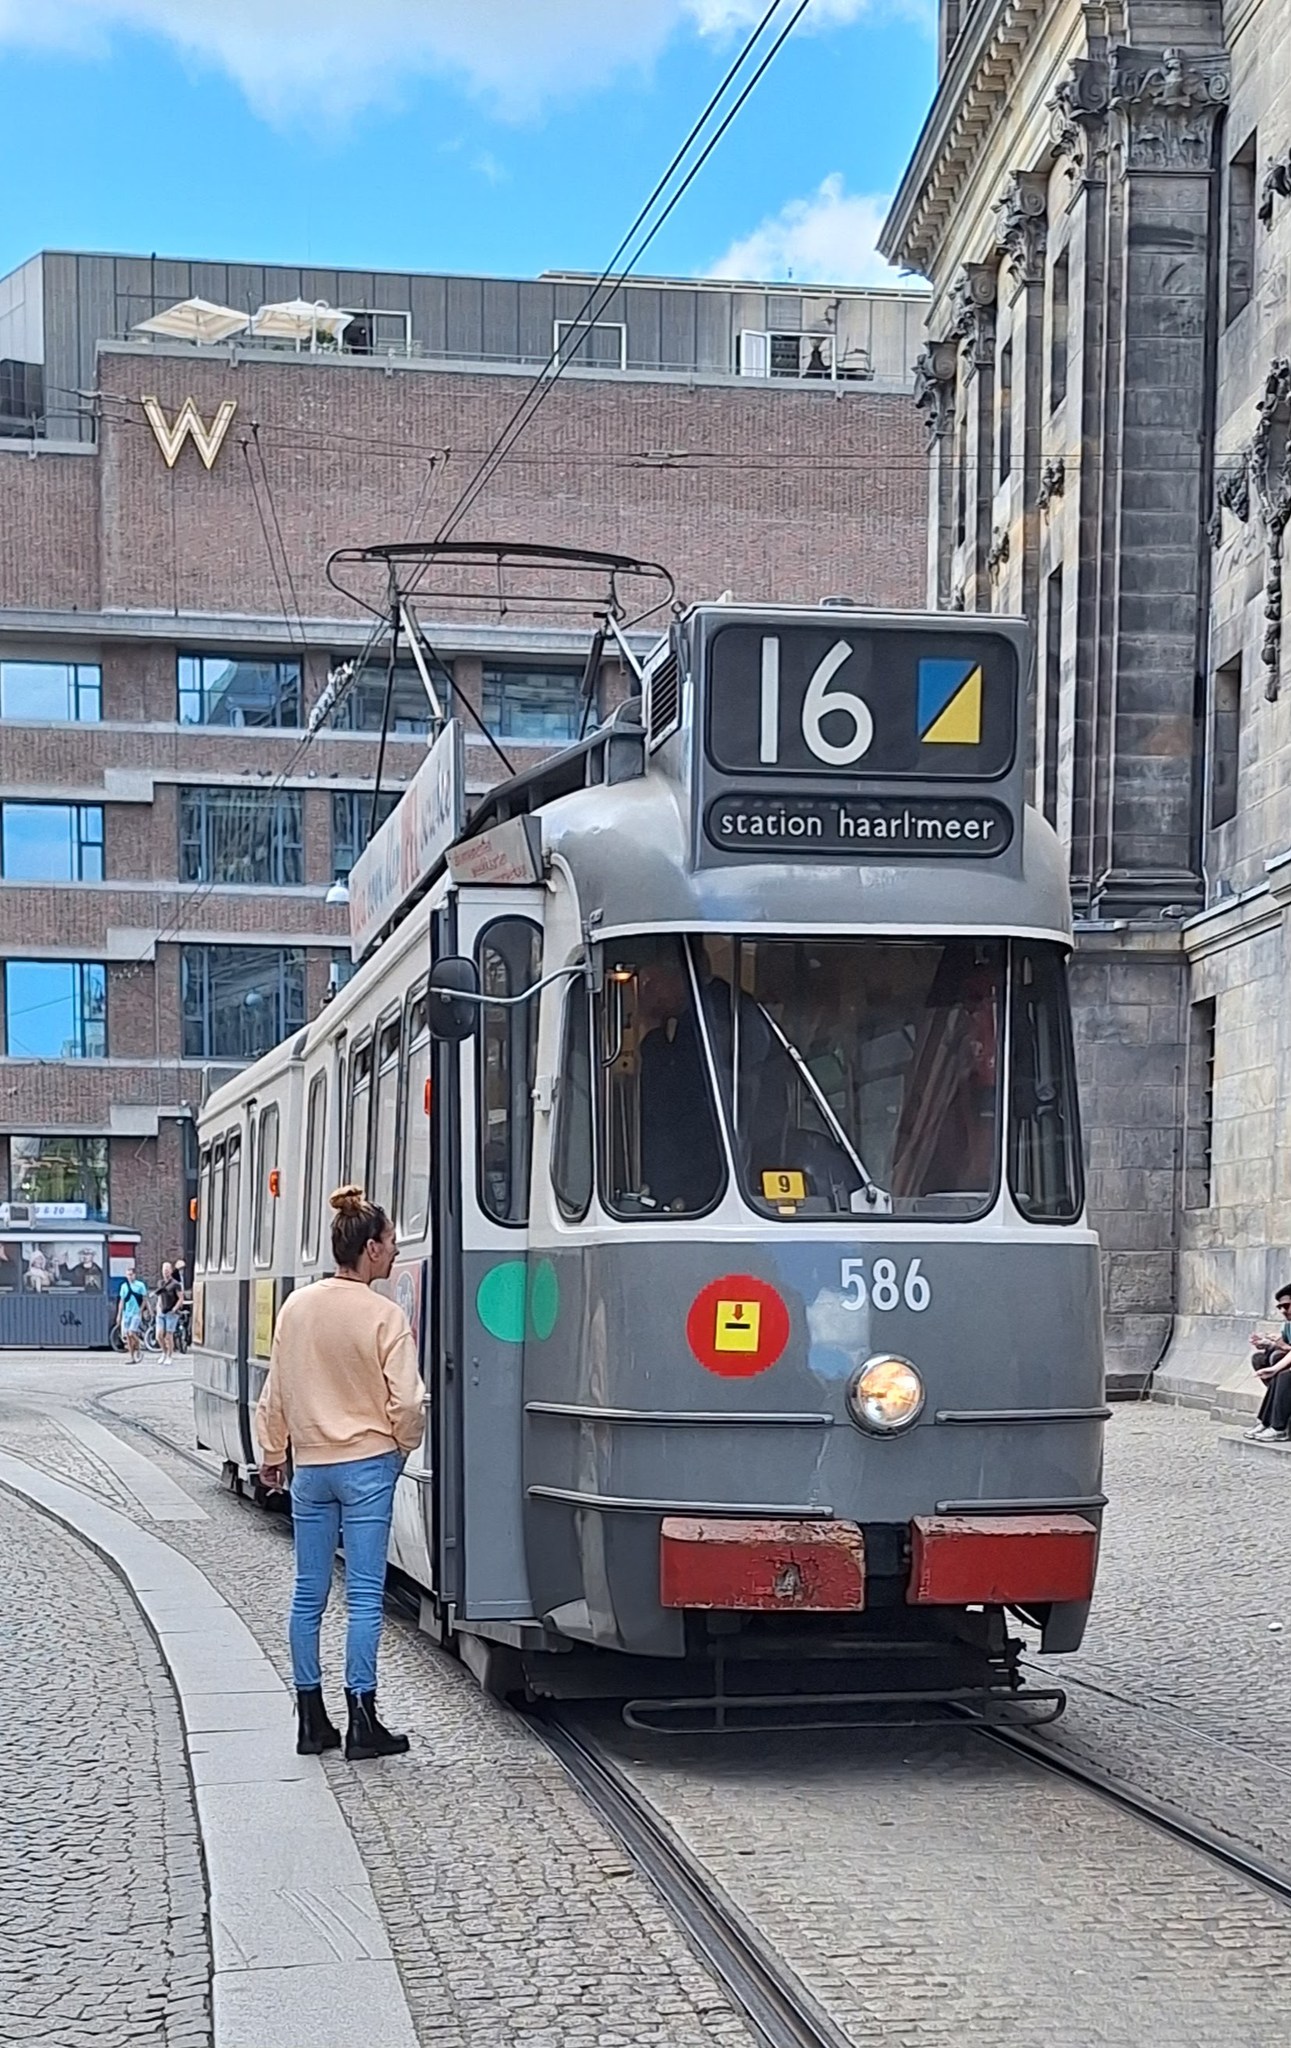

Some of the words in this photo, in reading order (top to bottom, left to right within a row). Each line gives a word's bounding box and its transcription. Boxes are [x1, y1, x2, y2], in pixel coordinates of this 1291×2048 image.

[142, 396, 238, 469] W
[760, 636, 873, 765] 16
[721, 810, 822, 836] station
[777, 1175, 791, 1193] 9
[840, 1258, 931, 1312] 586
